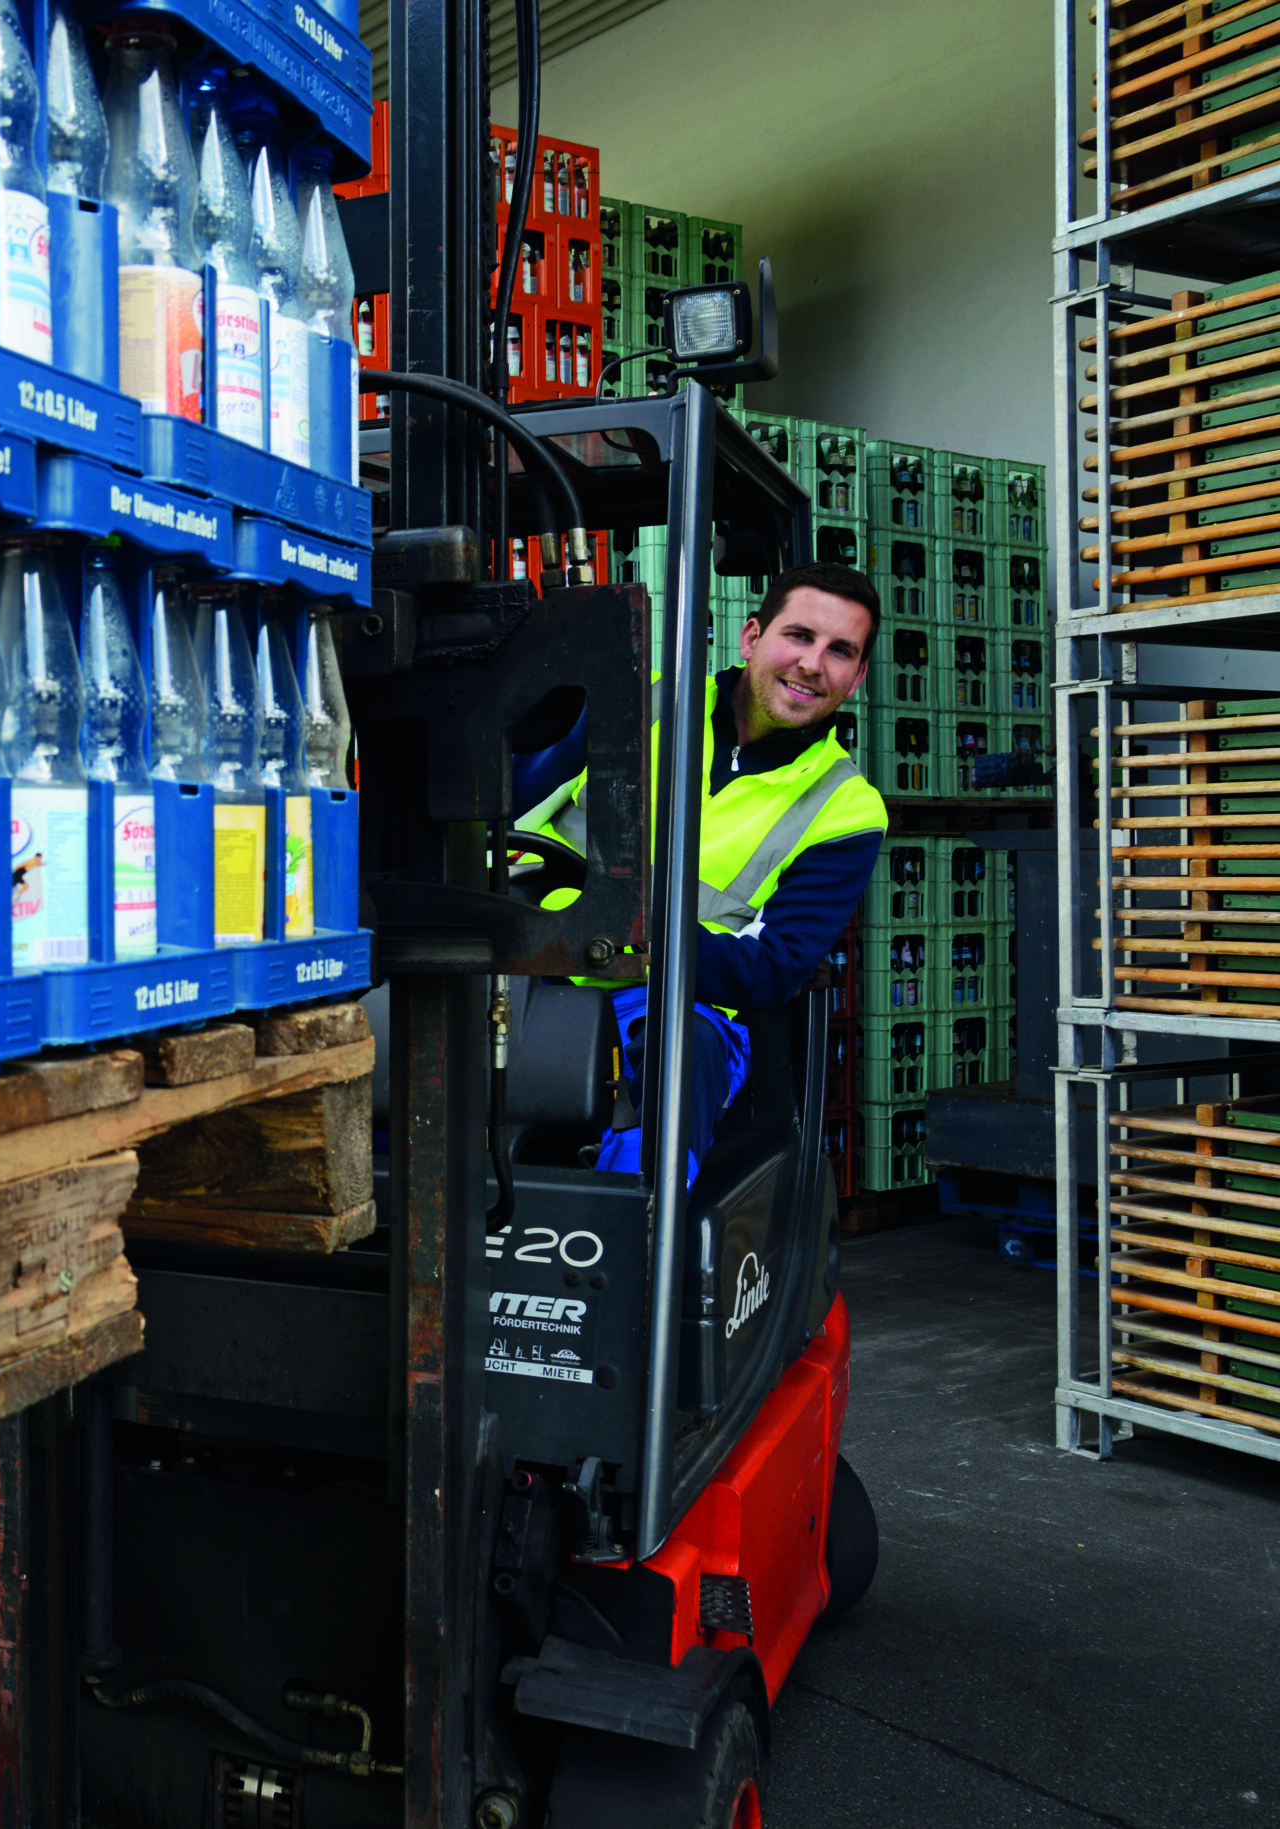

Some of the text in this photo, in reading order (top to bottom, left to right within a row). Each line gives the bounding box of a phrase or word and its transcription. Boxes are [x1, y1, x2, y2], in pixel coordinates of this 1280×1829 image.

[323, 29, 344, 62] Liter
[67, 397, 98, 432] Liter
[110, 485, 217, 540] Der Umwelt zuliebe!
[281, 539, 358, 581] Der Umwelt zuliebe!
[325, 958, 343, 980] Liter
[174, 979, 199, 1003] Liter
[725, 1251, 770, 1339] Linde
[493, 1315, 581, 1336] FÖRDERTECHNIK
[542, 1366, 581, 1381] MIETE
